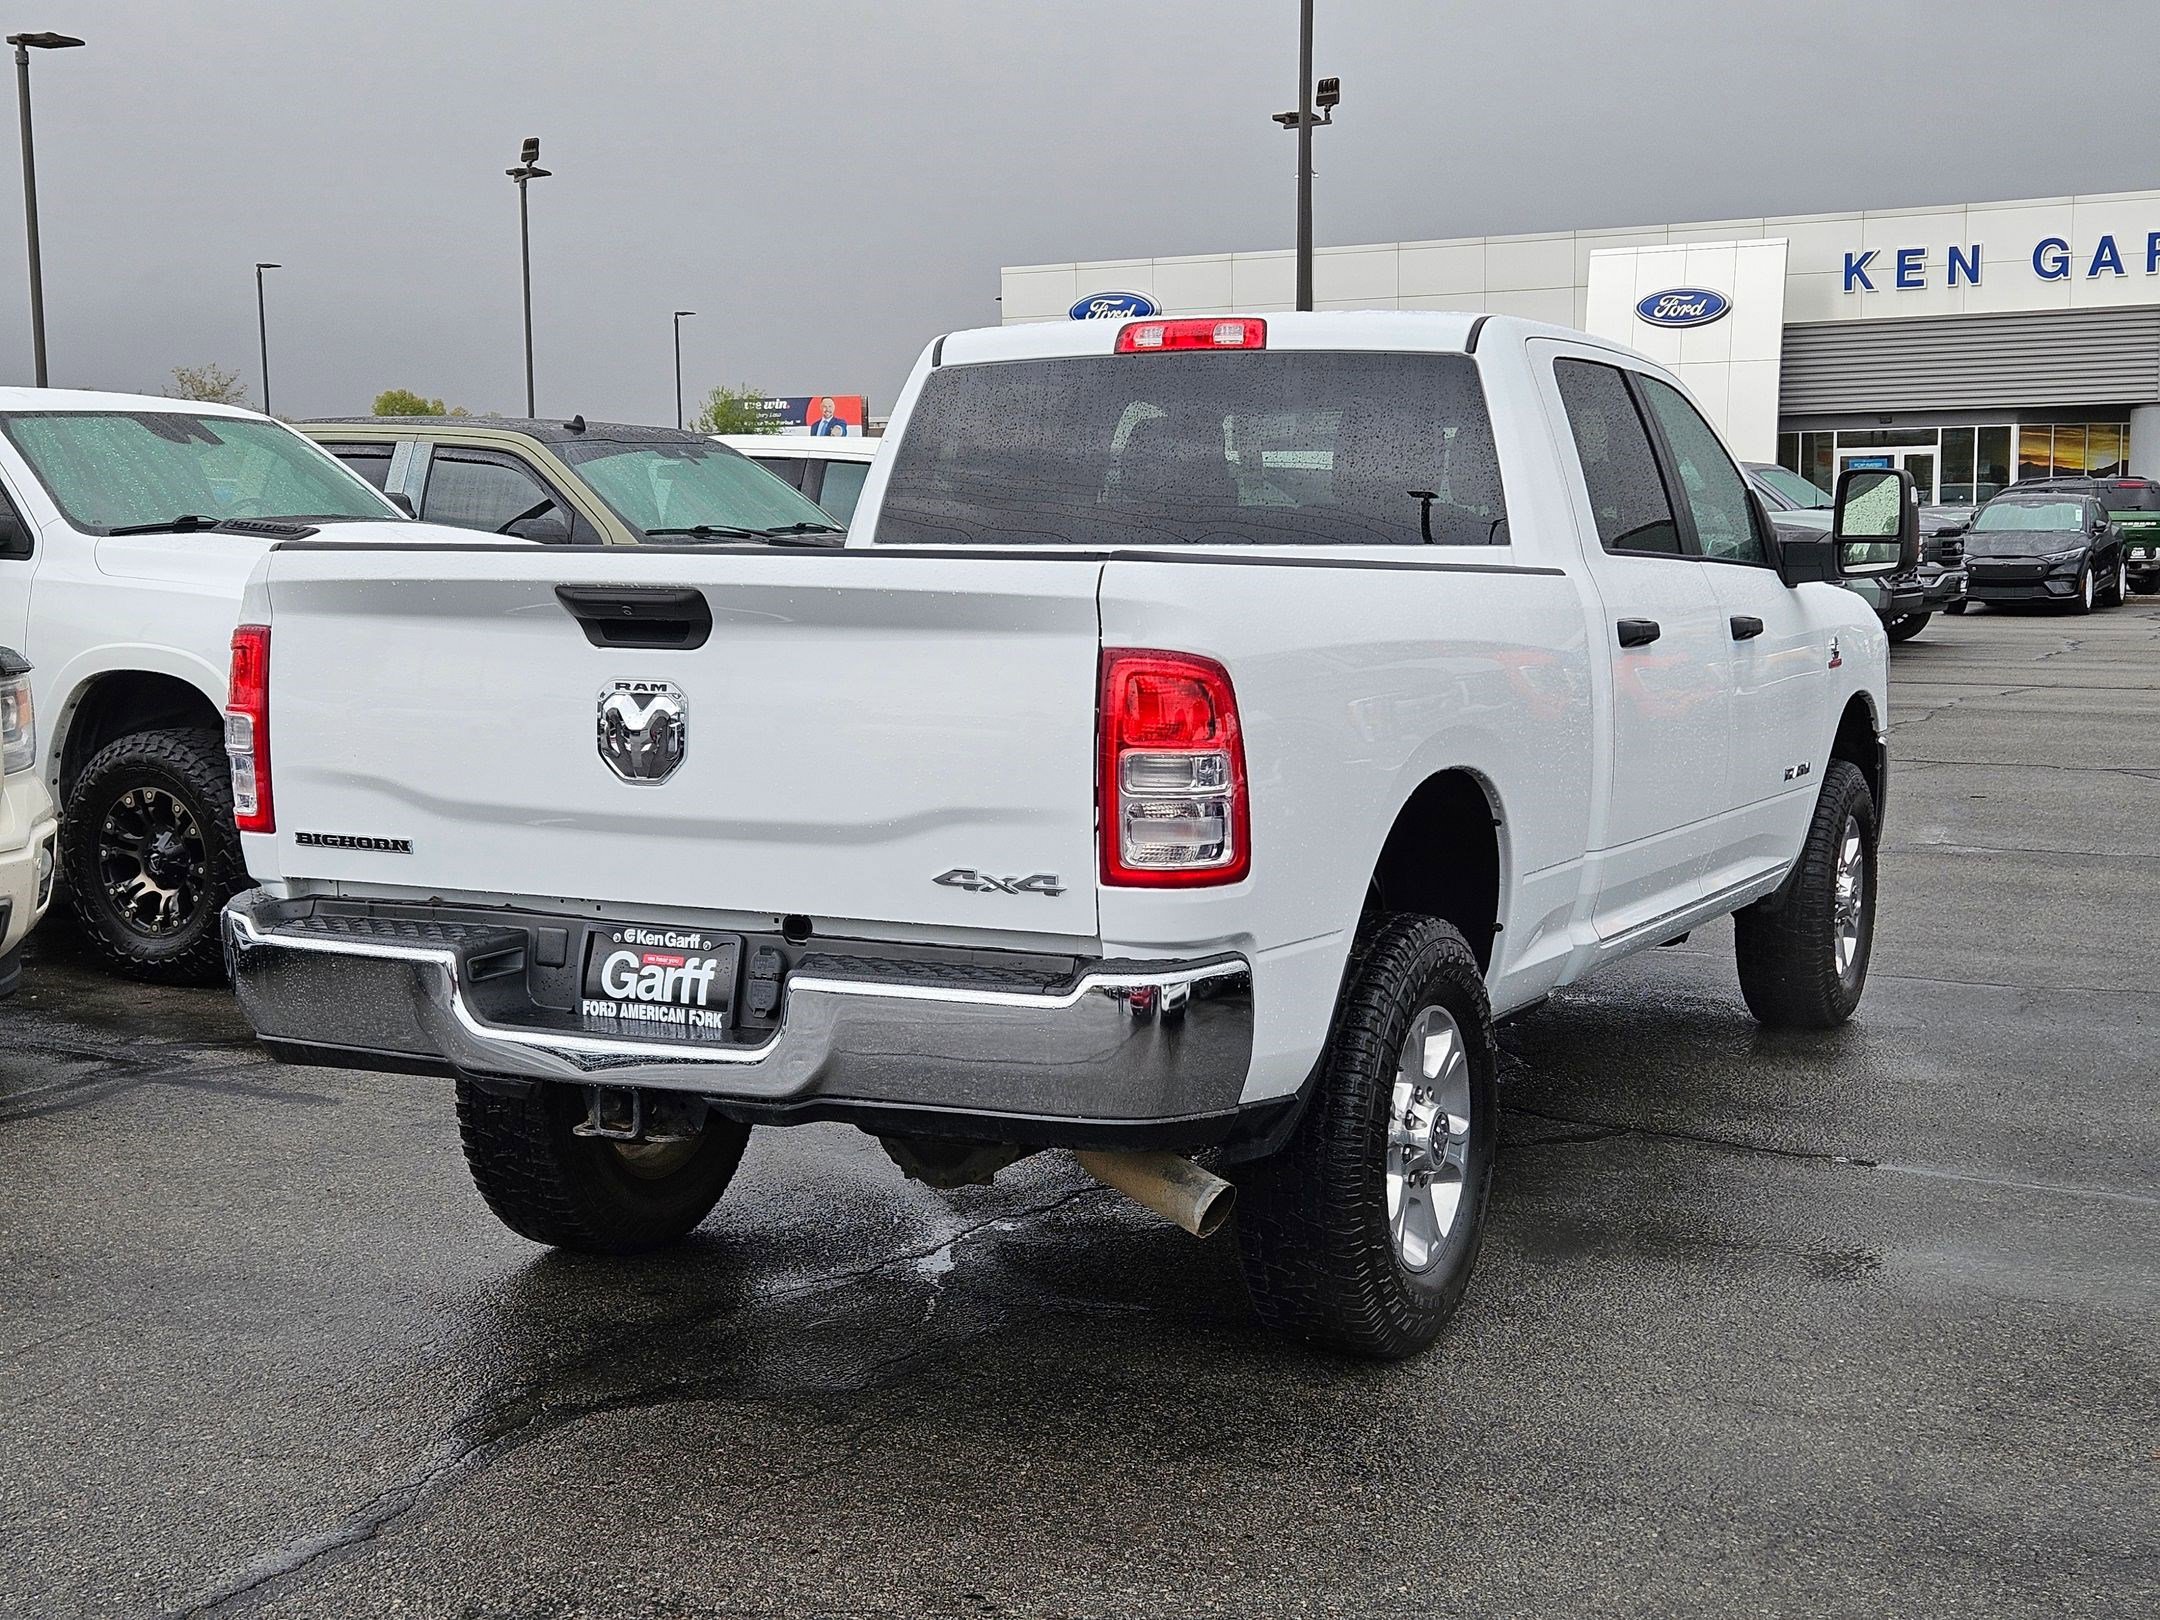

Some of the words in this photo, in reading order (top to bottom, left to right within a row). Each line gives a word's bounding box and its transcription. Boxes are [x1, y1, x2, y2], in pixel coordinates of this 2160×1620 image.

[1843, 242, 1983, 293] KEN
[1085, 299, 1137, 320] Ford
[1653, 294, 1708, 317] Ford
[614, 682, 668, 692] RAM
[294, 831, 414, 855] BIGHORN
[931, 868, 1067, 898] 4x4
[636, 929, 664, 947] Ken
[664, 931, 701, 949] Garff
[601, 950, 717, 1006] Garff
[582, 1000, 617, 1018] FORD
[619, 1002, 686, 1024] AMERICAN
[688, 1008, 722, 1029] FORK
